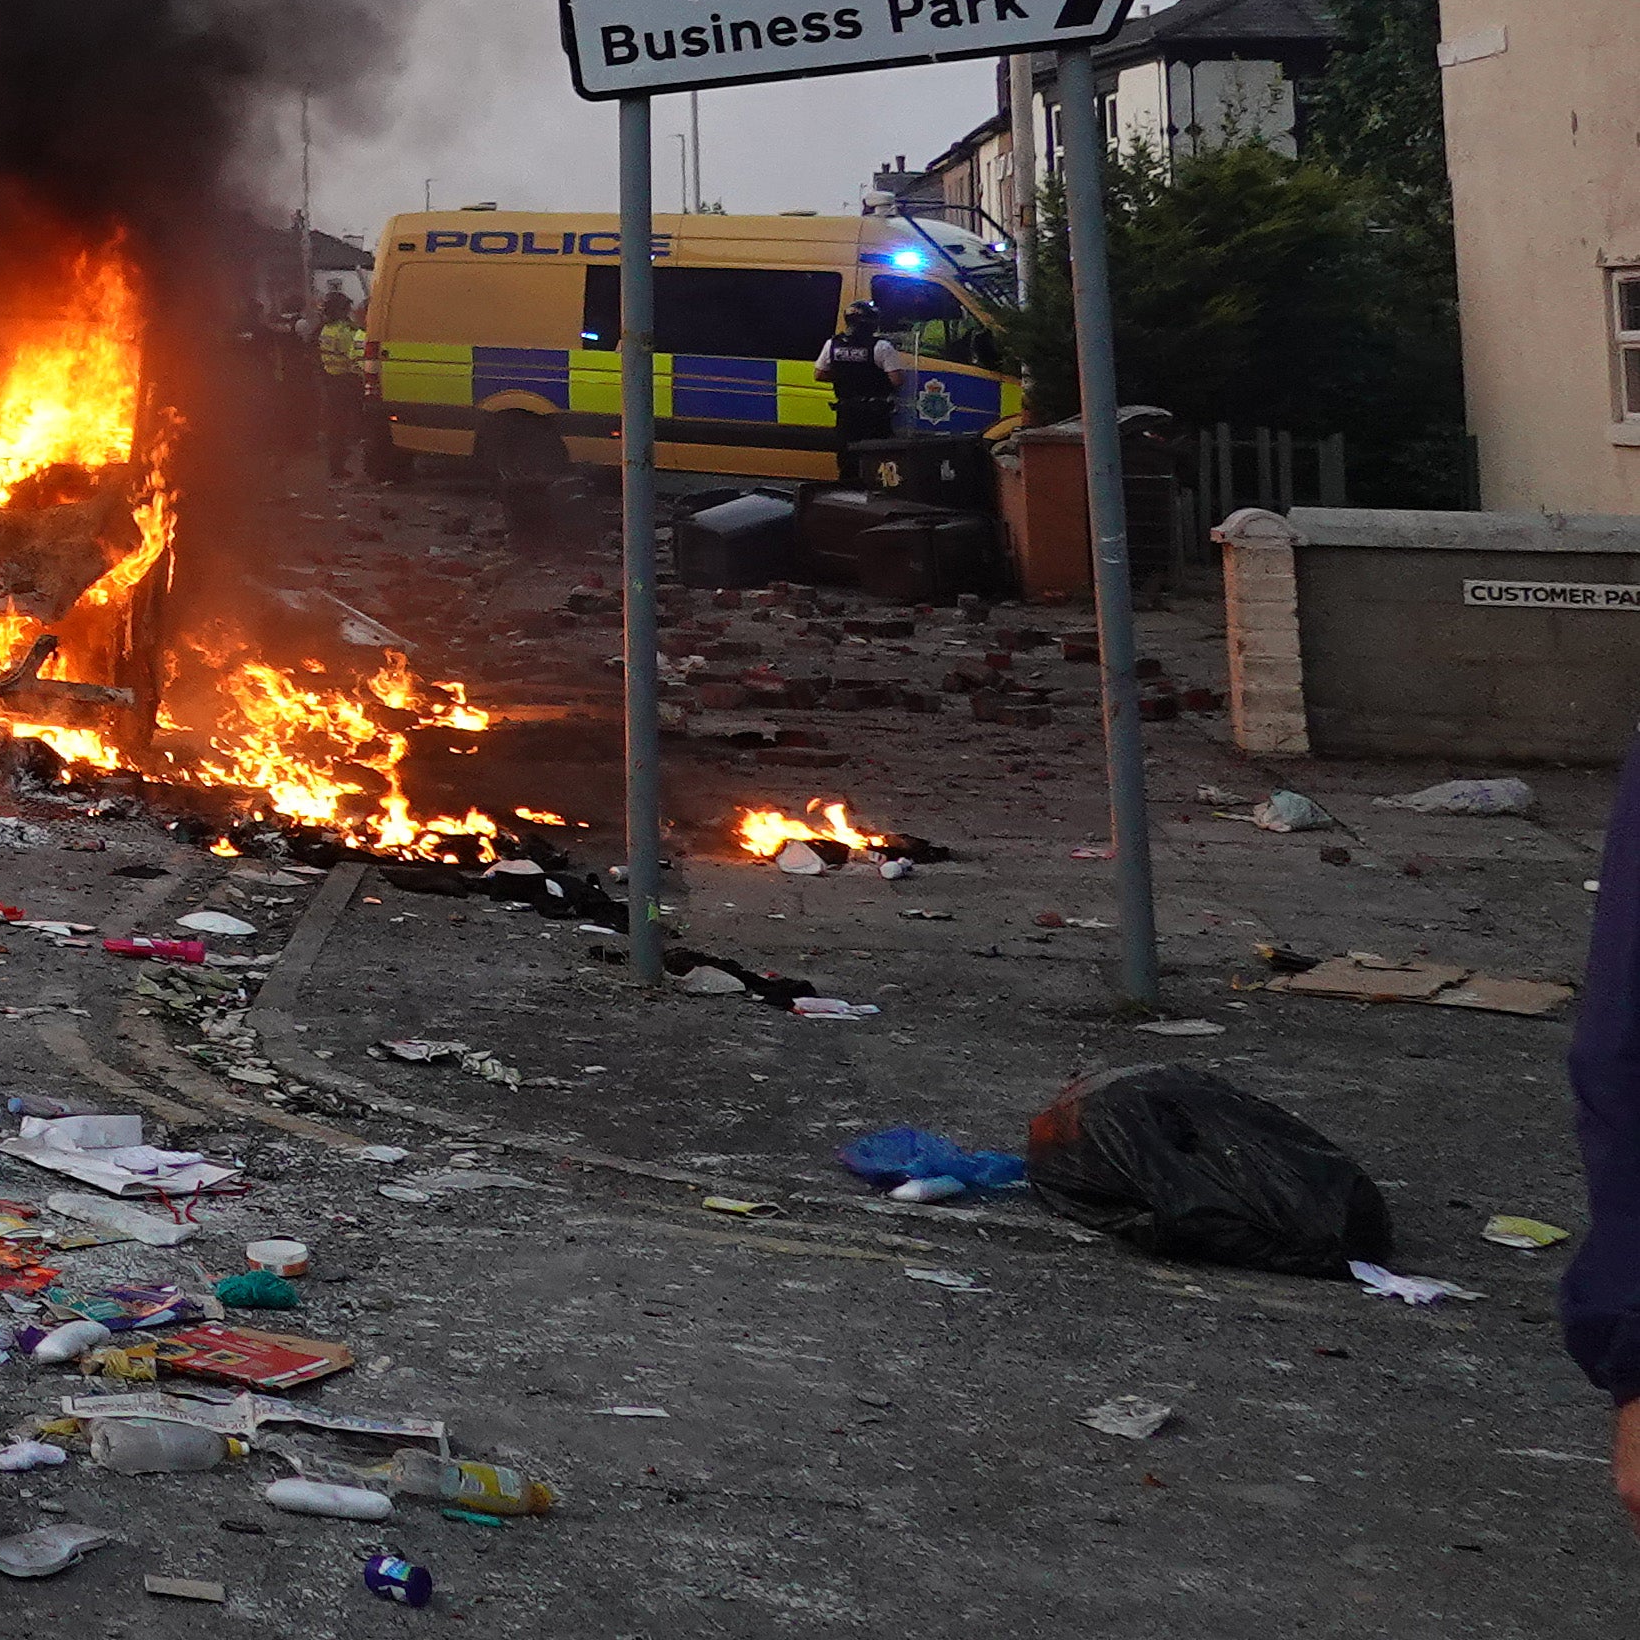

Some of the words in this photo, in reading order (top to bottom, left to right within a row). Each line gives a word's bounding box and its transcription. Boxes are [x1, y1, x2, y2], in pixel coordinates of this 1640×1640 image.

[600, 6, 863, 67] Business
[425, 230, 672, 257] POLICE
[1471, 585, 1596, 605] CUSTOMER
